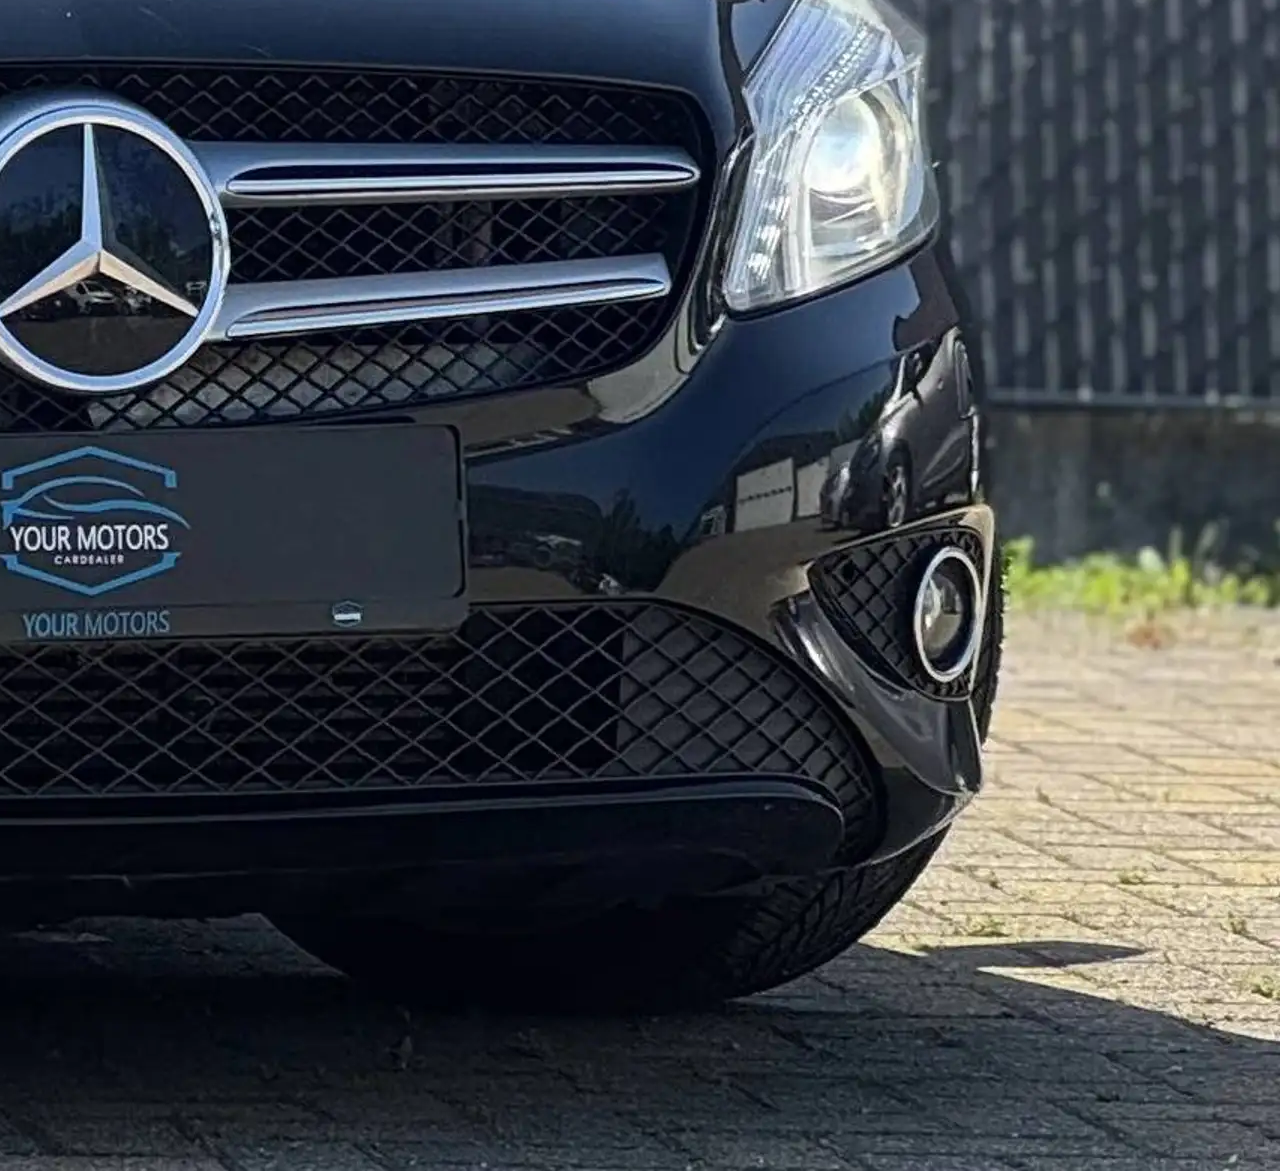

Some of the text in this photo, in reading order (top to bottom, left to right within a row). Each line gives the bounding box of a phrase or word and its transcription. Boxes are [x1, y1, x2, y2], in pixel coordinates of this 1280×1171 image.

[10, 523, 169, 552] YOUR MOTORS
[54, 554, 125, 565] CARDEALER
[22, 609, 172, 639] YOUR MOTORS
